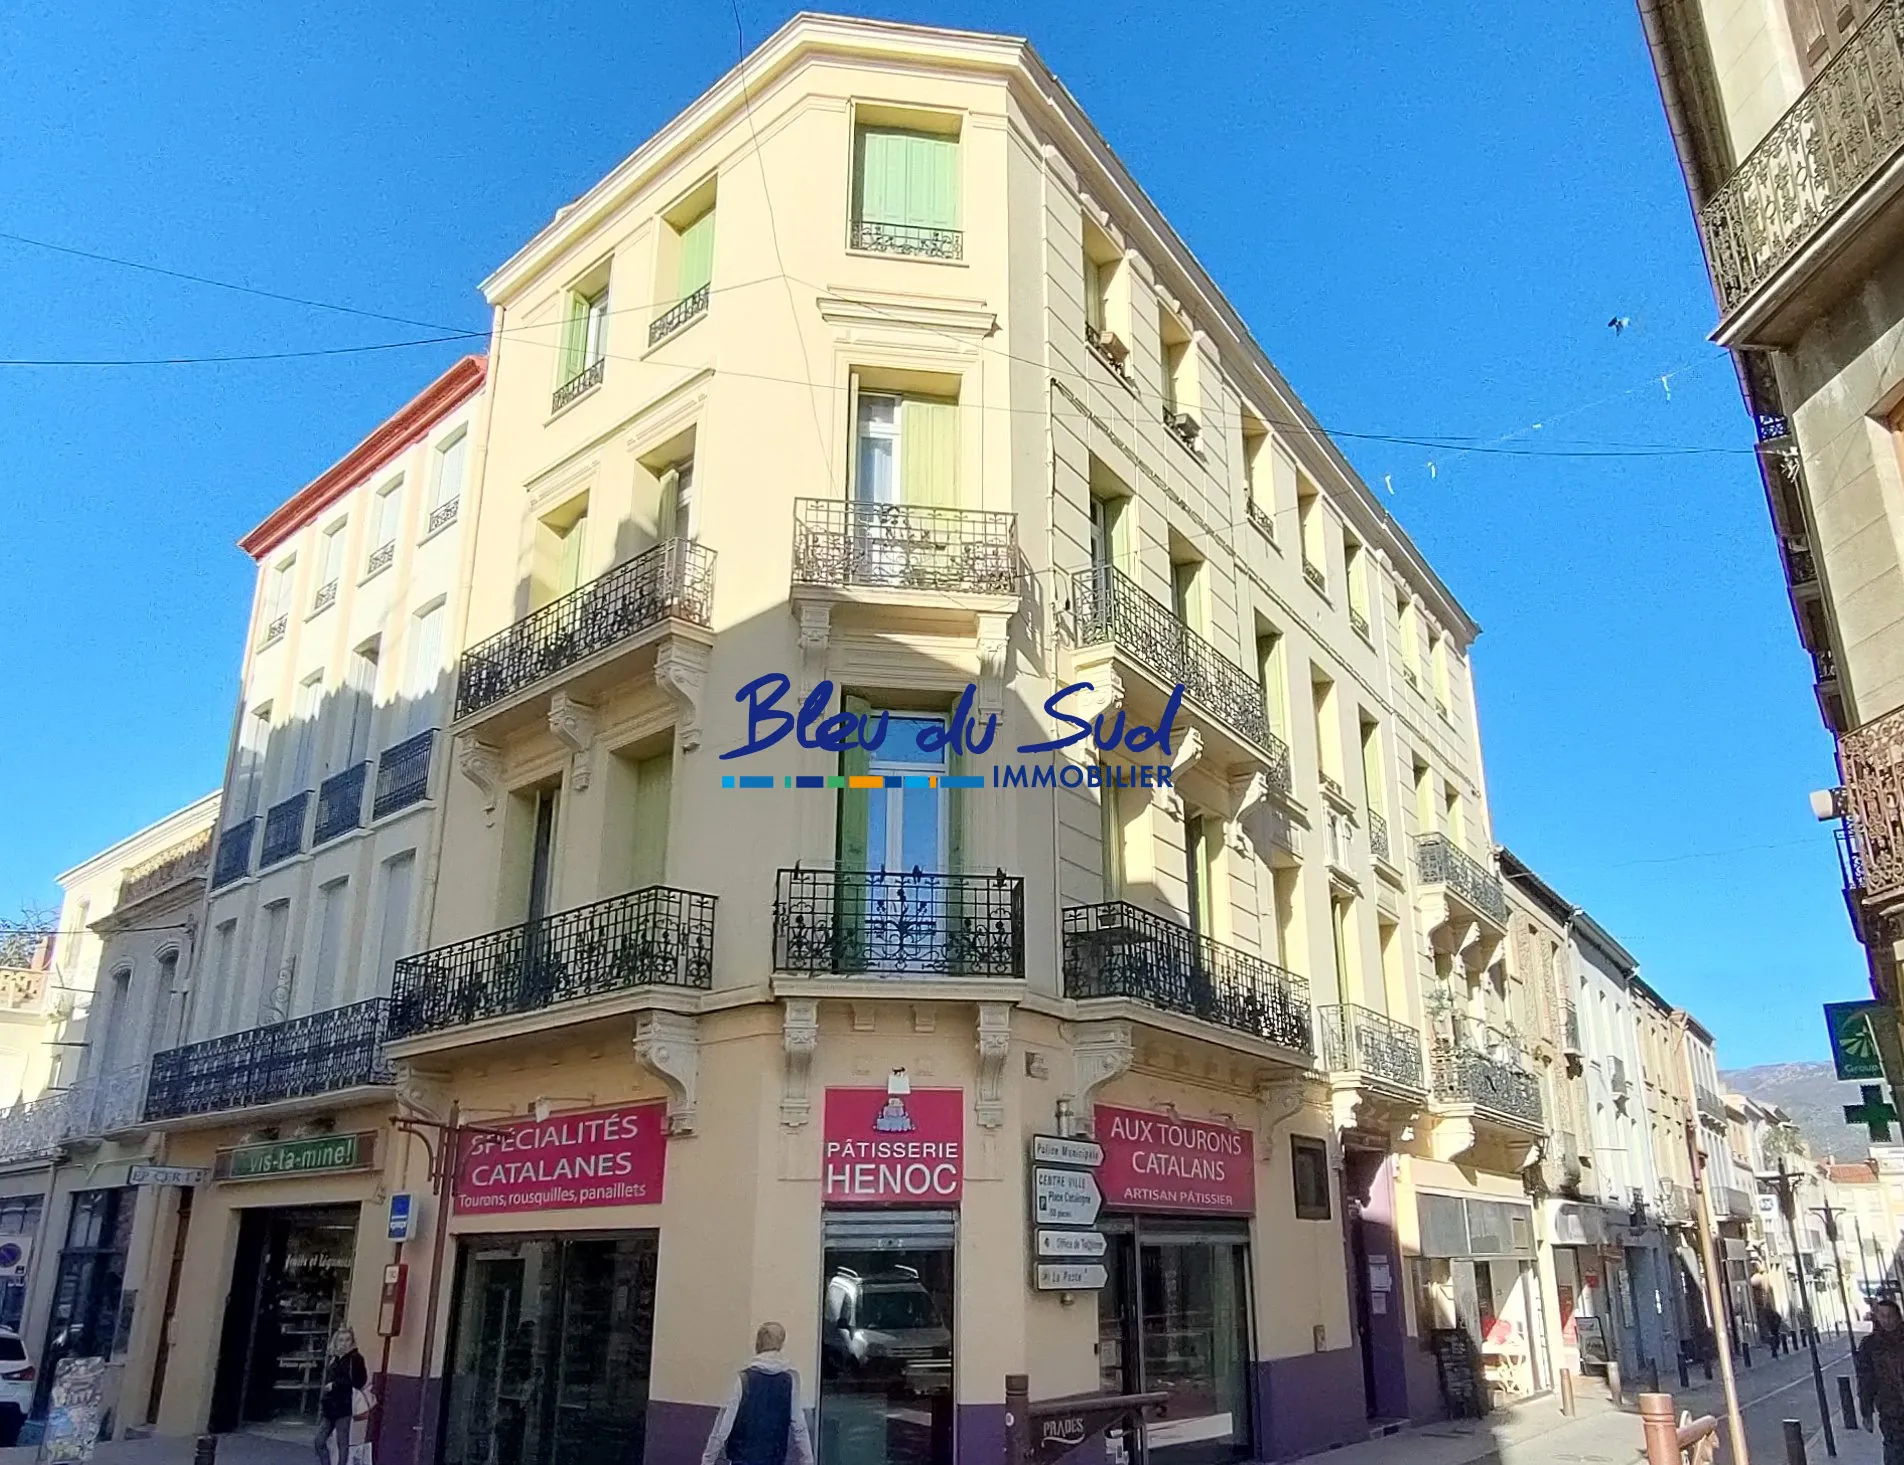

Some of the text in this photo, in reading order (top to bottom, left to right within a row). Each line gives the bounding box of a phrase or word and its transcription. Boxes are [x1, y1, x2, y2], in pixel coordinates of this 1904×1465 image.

[470, 1113, 639, 1156] SPÉCIALITÉS
[1111, 1116, 1242, 1156] AUX TOURONS
[827, 1139, 959, 1158] PÂTISSERIE
[1037, 1143, 1059, 1156] Police
[472, 1151, 633, 1187] CATALANES
[1132, 1150, 1226, 1182] CATALANS
[827, 1162, 957, 1195] HENOC
[1039, 1174, 1065, 1188] CENTRE
[508, 1186, 577, 1206] rousquilles,
[580, 1182, 646, 1204] panaillets
[1124, 1187, 1233, 1206] ARTISAN PÂTISSIER
[1052, 1271, 1060, 1282] La
